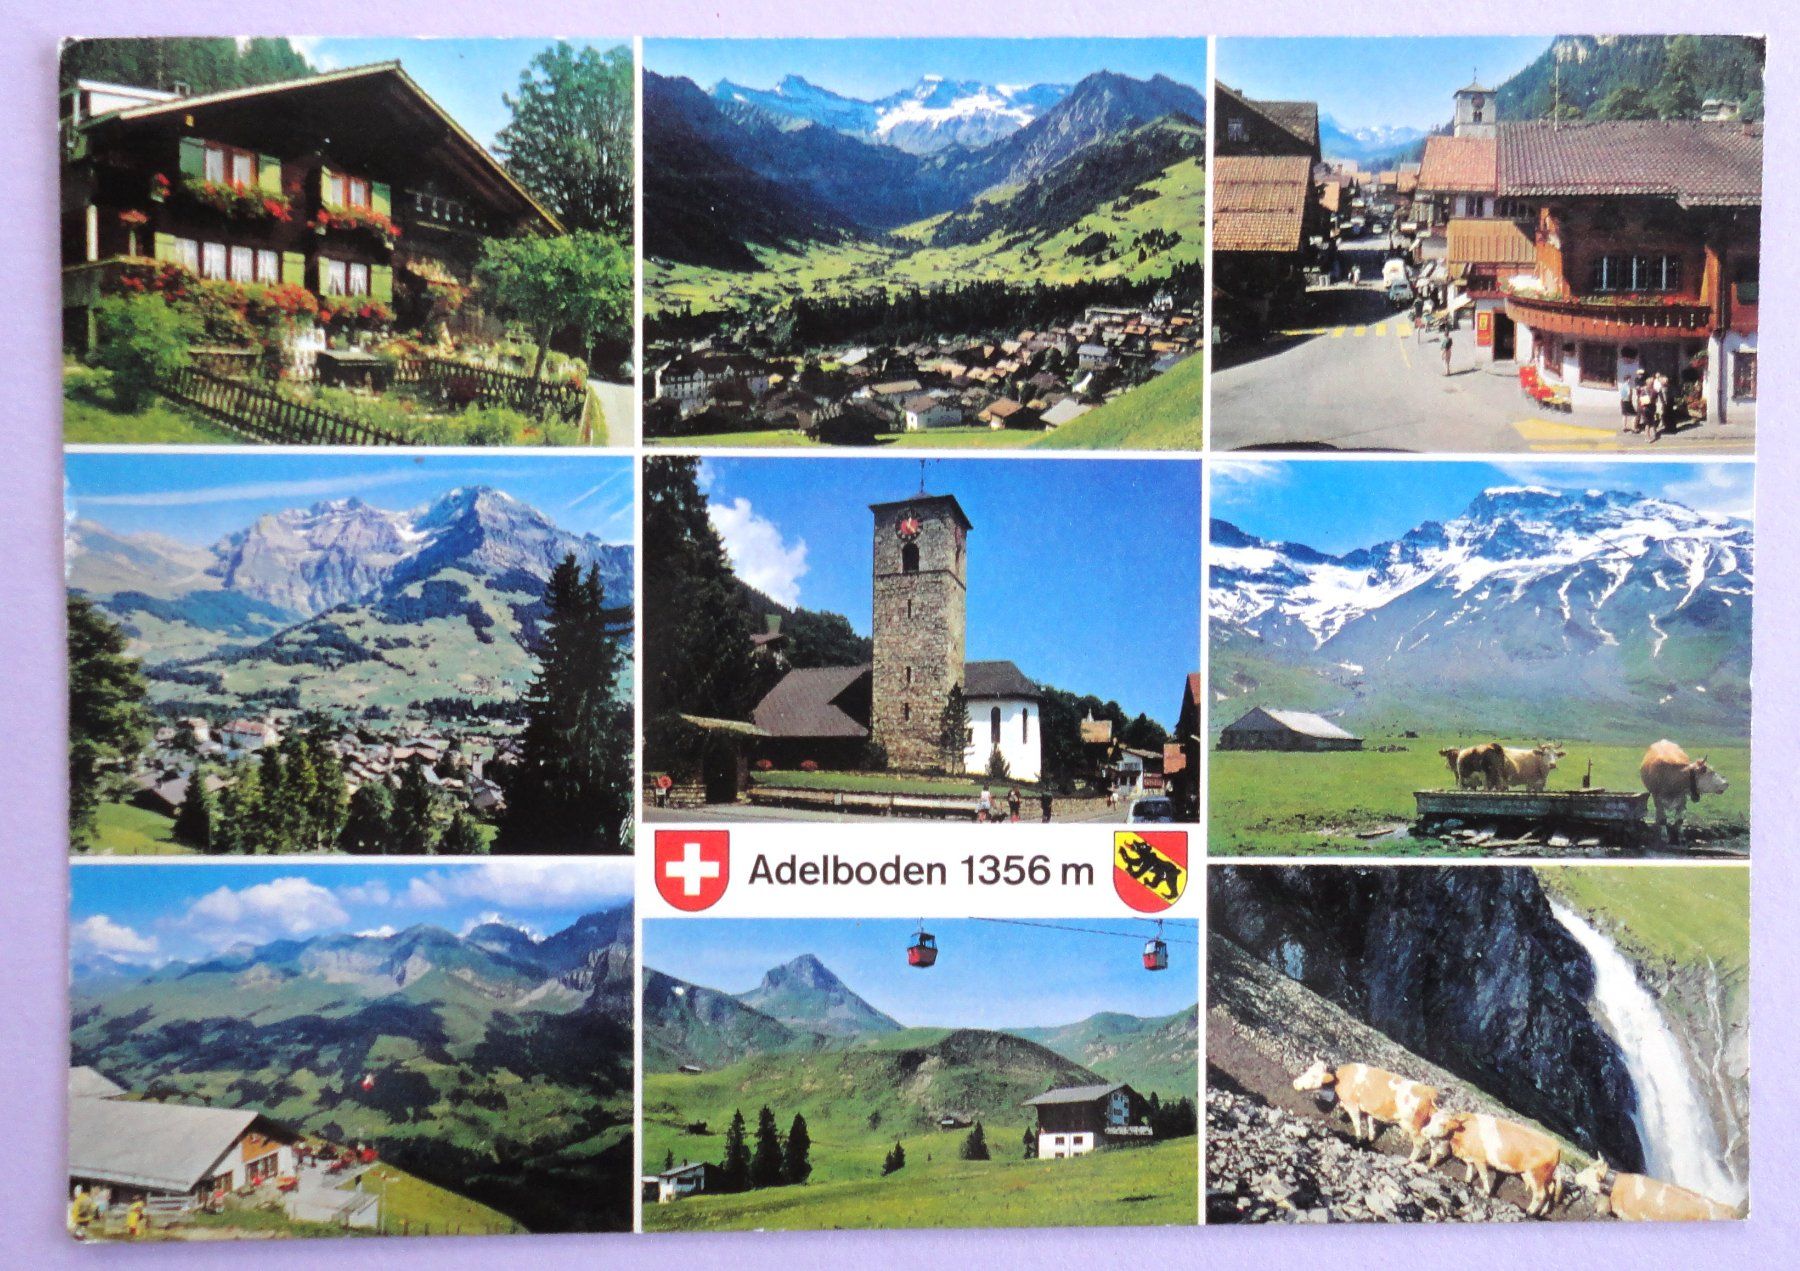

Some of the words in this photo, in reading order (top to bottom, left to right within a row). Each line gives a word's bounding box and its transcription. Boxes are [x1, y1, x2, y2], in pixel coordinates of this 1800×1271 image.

[748, 854, 947, 885] Adelboden
[961, 854, 1051, 885] 1356
[1061, 863, 1094, 885] m
